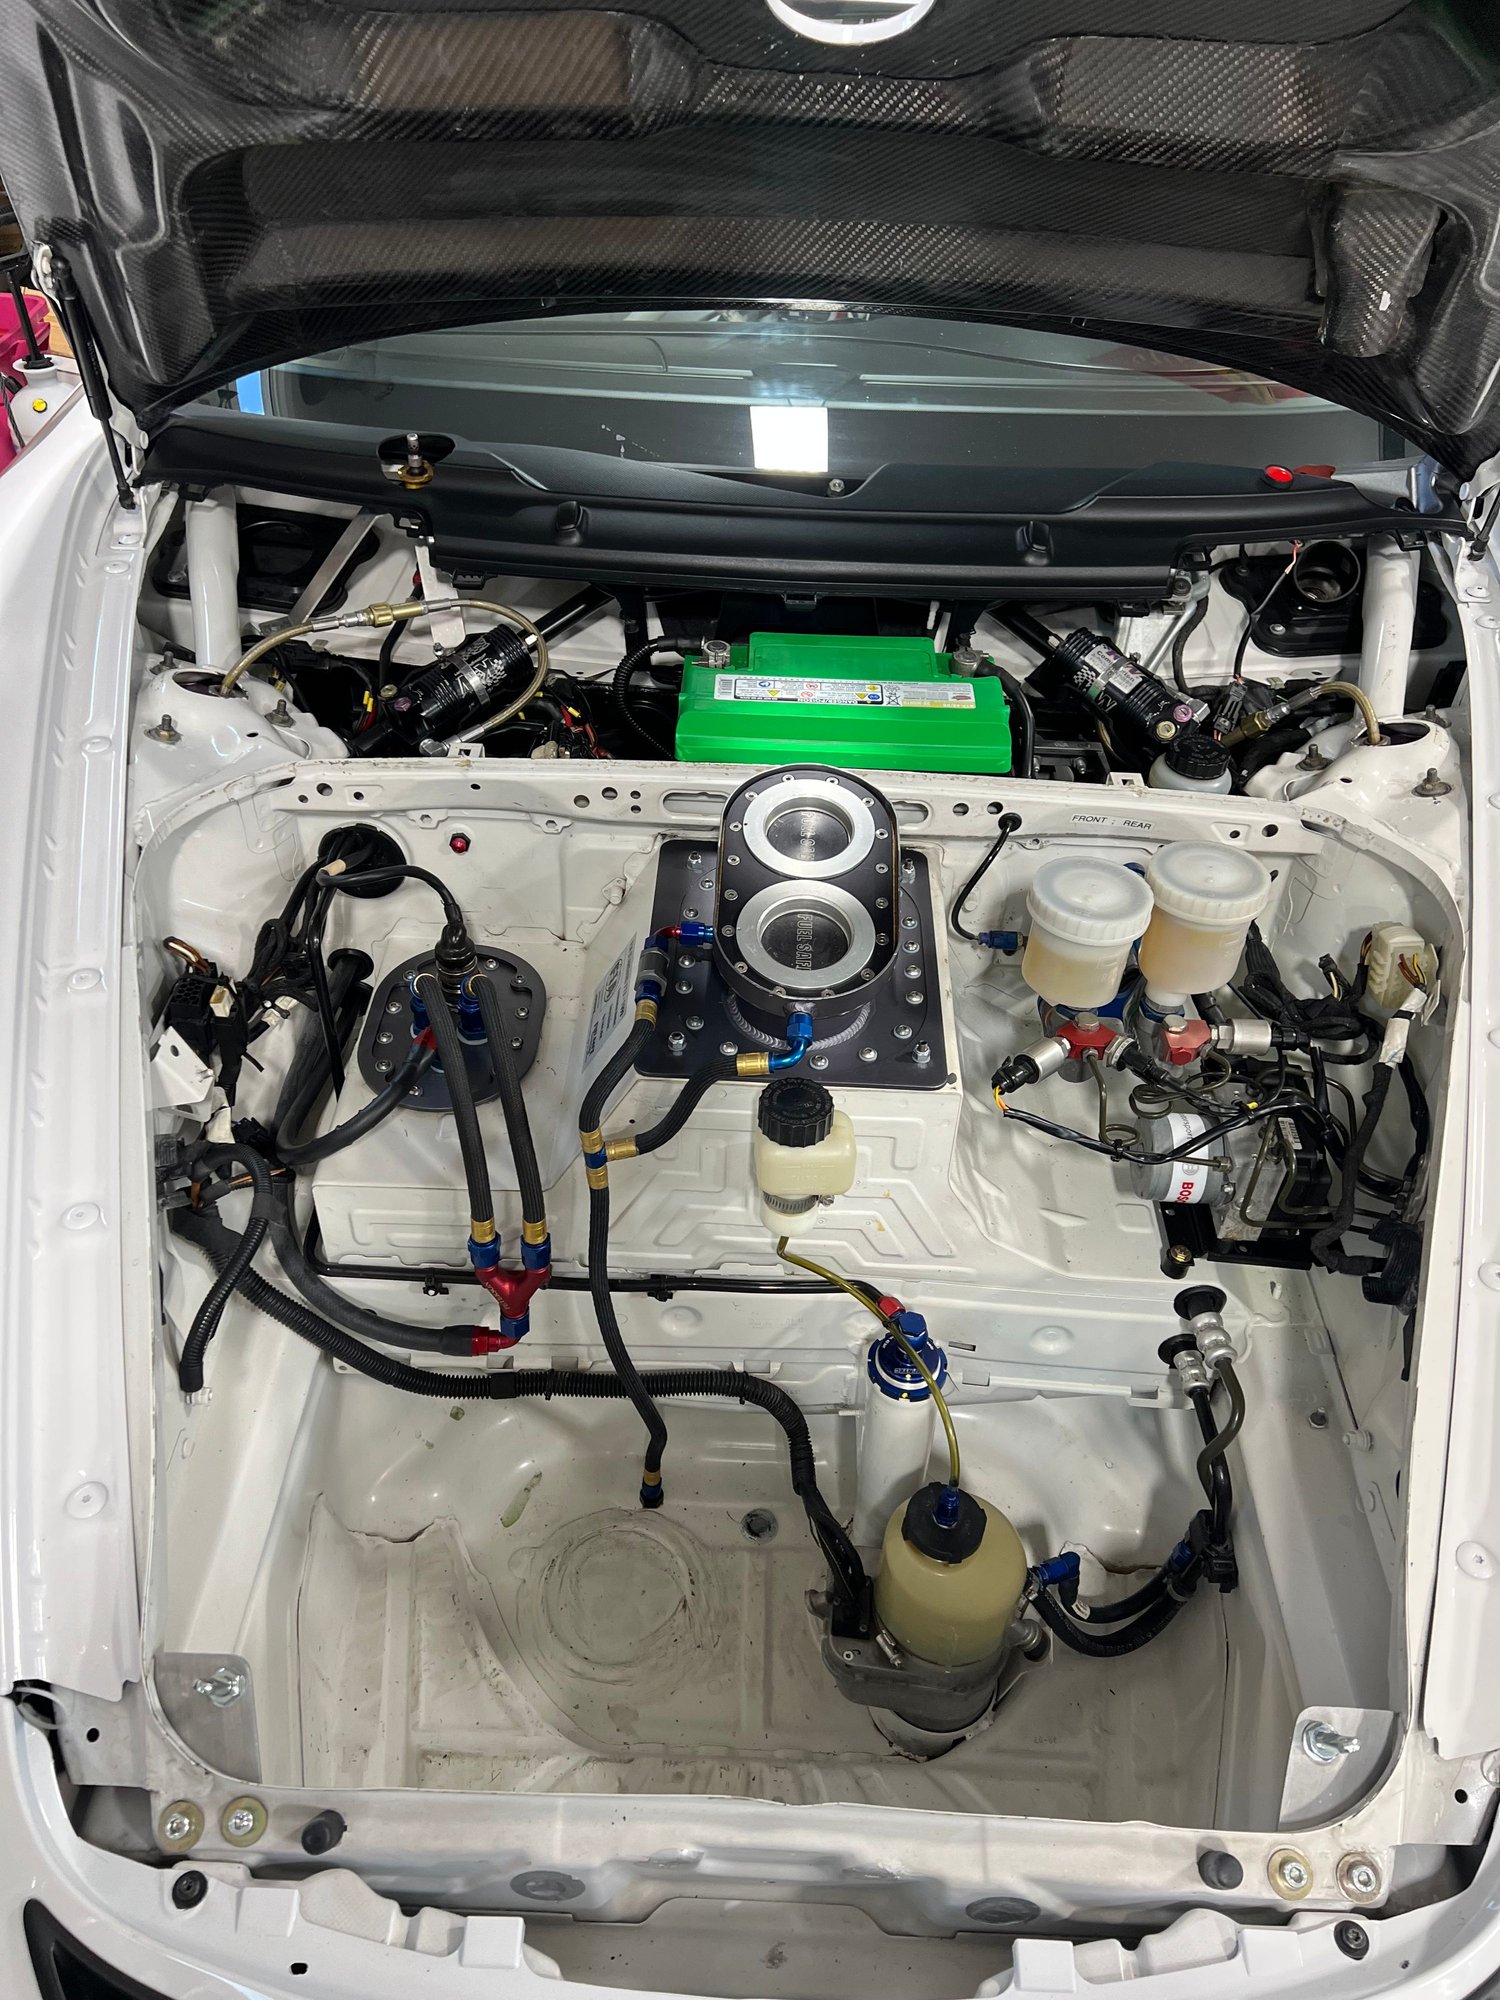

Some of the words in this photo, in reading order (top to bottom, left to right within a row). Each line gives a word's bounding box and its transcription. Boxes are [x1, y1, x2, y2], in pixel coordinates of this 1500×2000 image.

[1071, 814, 1108, 824] FRONT
[1122, 819, 1152, 830] REAR
[800, 838, 816, 861] SAF
[796, 913, 813, 942] FUEL
